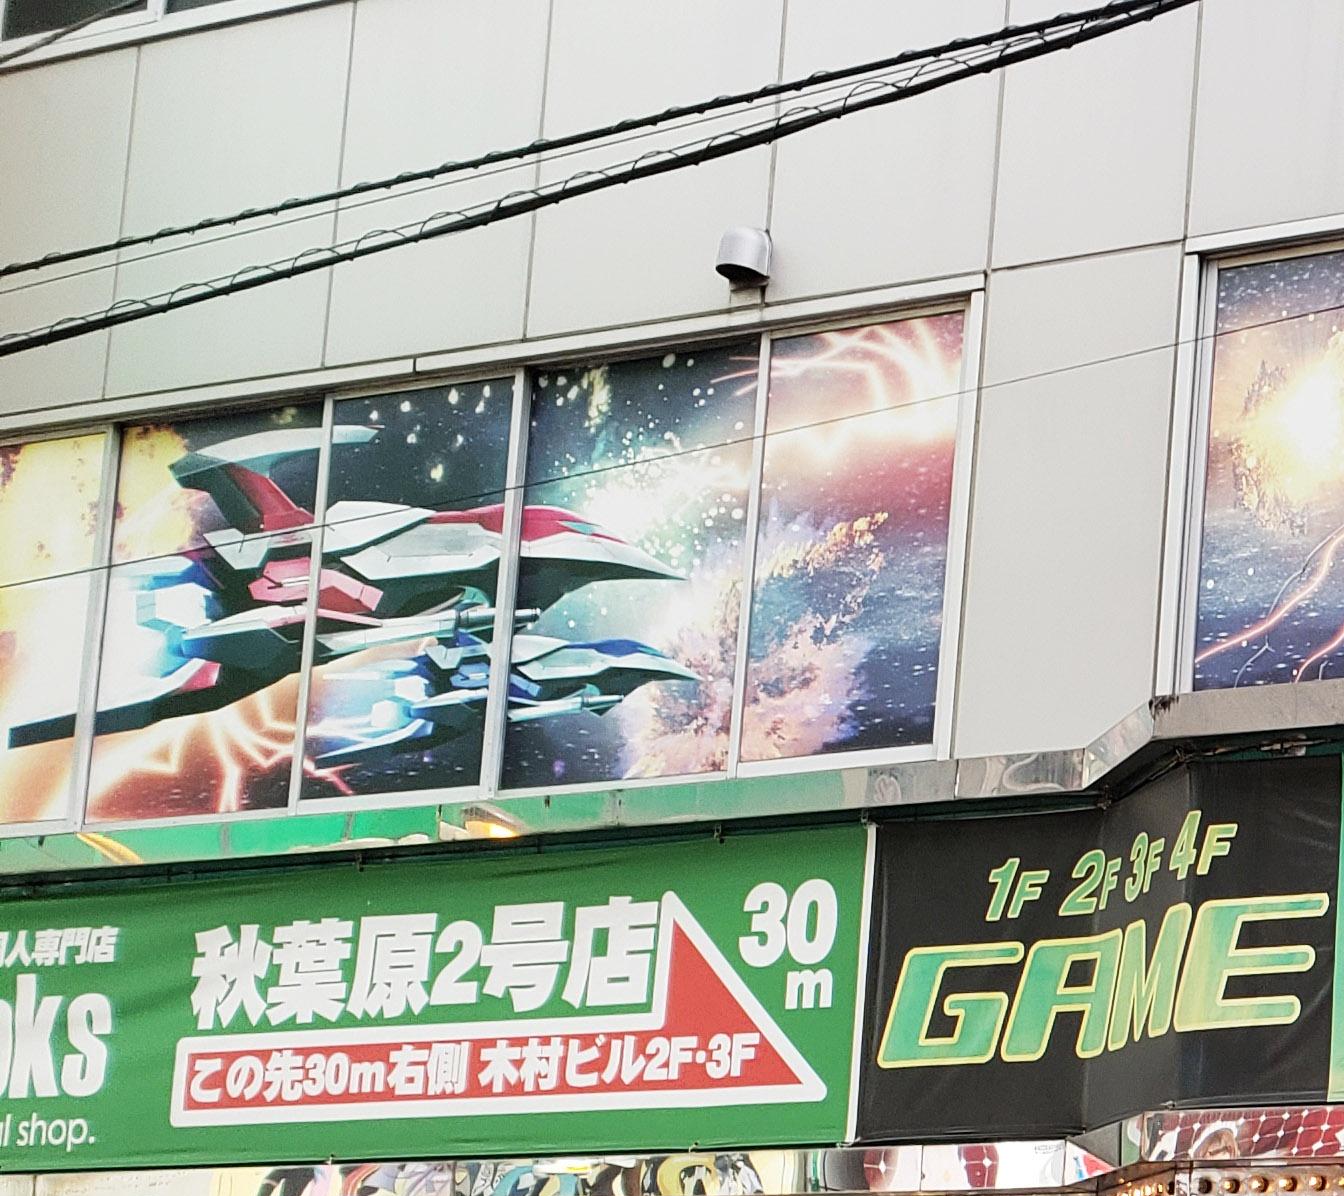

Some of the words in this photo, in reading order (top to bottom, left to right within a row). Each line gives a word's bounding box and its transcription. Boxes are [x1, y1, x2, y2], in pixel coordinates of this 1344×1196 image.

[985, 857, 1050, 922] 1F
[1058, 849, 1122, 916] 2F
[1124, 831, 1166, 902] 3F
[1169, 810, 1238, 880] 4F
[190, 896, 660, 1031] 秋葉原2号店
[738, 878, 838, 967] 30
[785, 968, 834, 1010] m
[876, 893, 1330, 1069] GAME
[190, 1041, 467, 1104] この先30m右側
[16, 1112, 96, 1152] shop.
